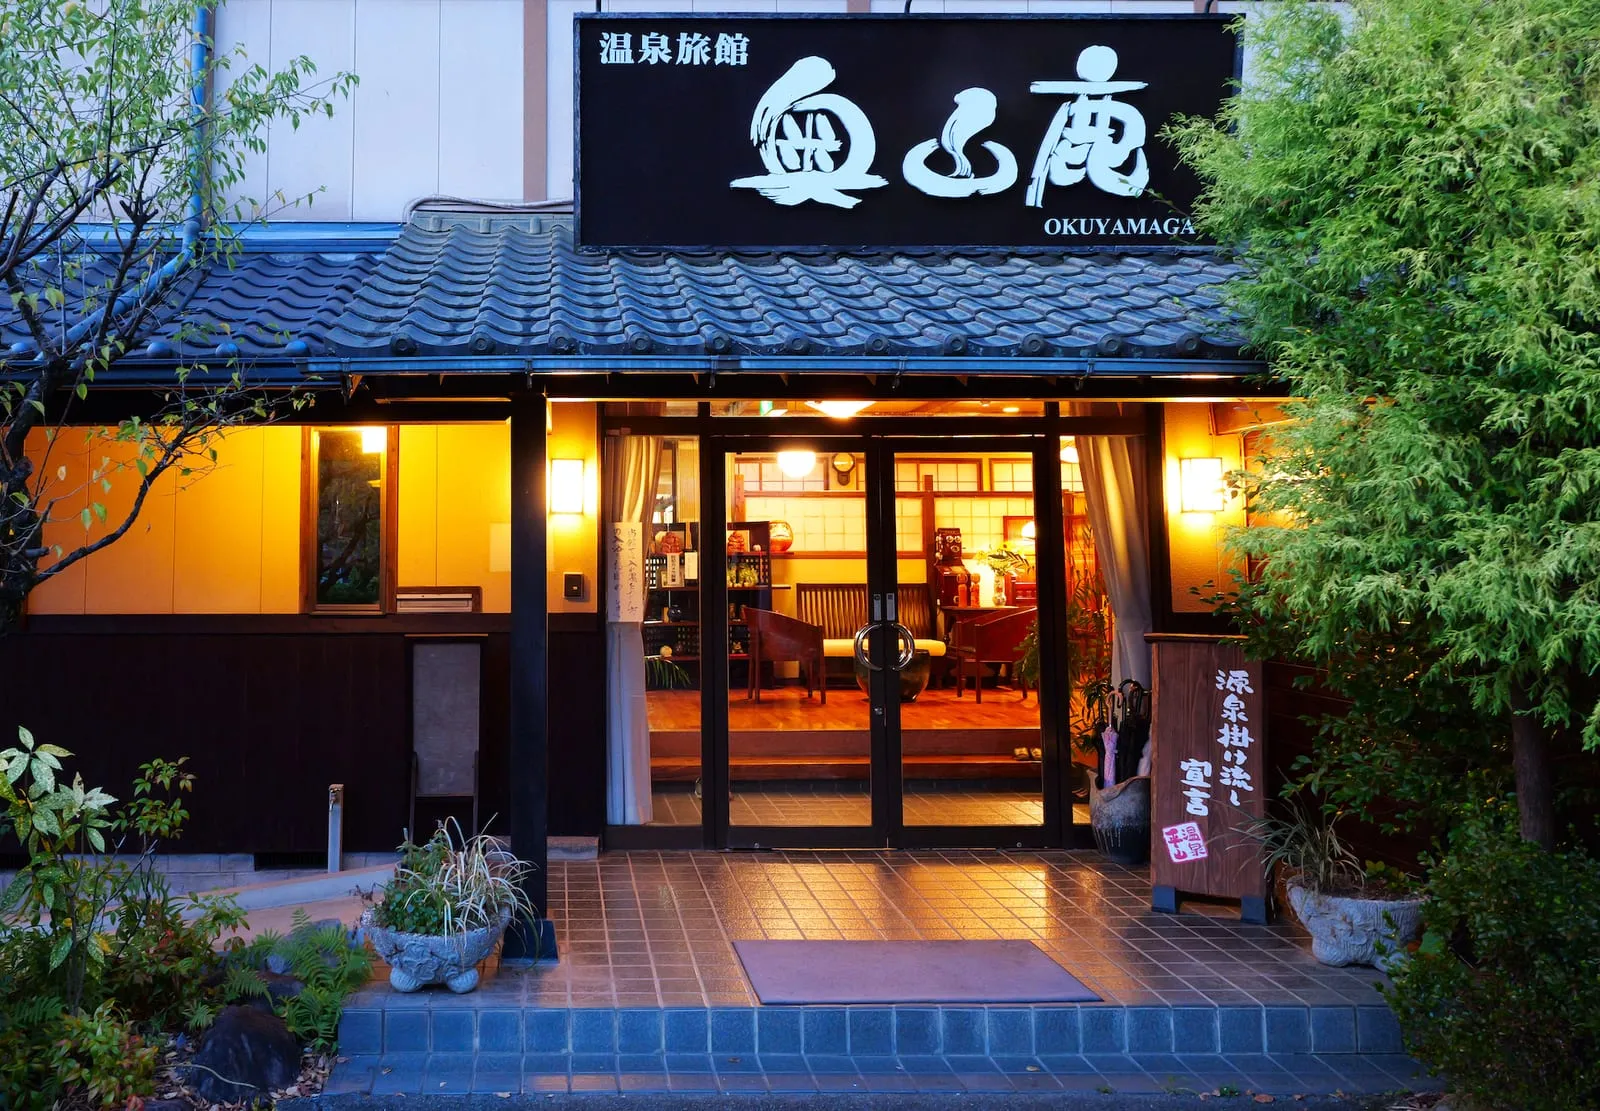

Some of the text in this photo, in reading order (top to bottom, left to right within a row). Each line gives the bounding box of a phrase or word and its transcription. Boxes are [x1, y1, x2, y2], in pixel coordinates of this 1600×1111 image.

[599, 32, 750, 65] 温泉旅館
[1044, 217, 1196, 236] OKUYAMAGA
[1215, 669, 1254, 806] 源泉掛け流し
[1180, 758, 1212, 816] 宣言
[1181, 826, 1206, 857] 温泉
